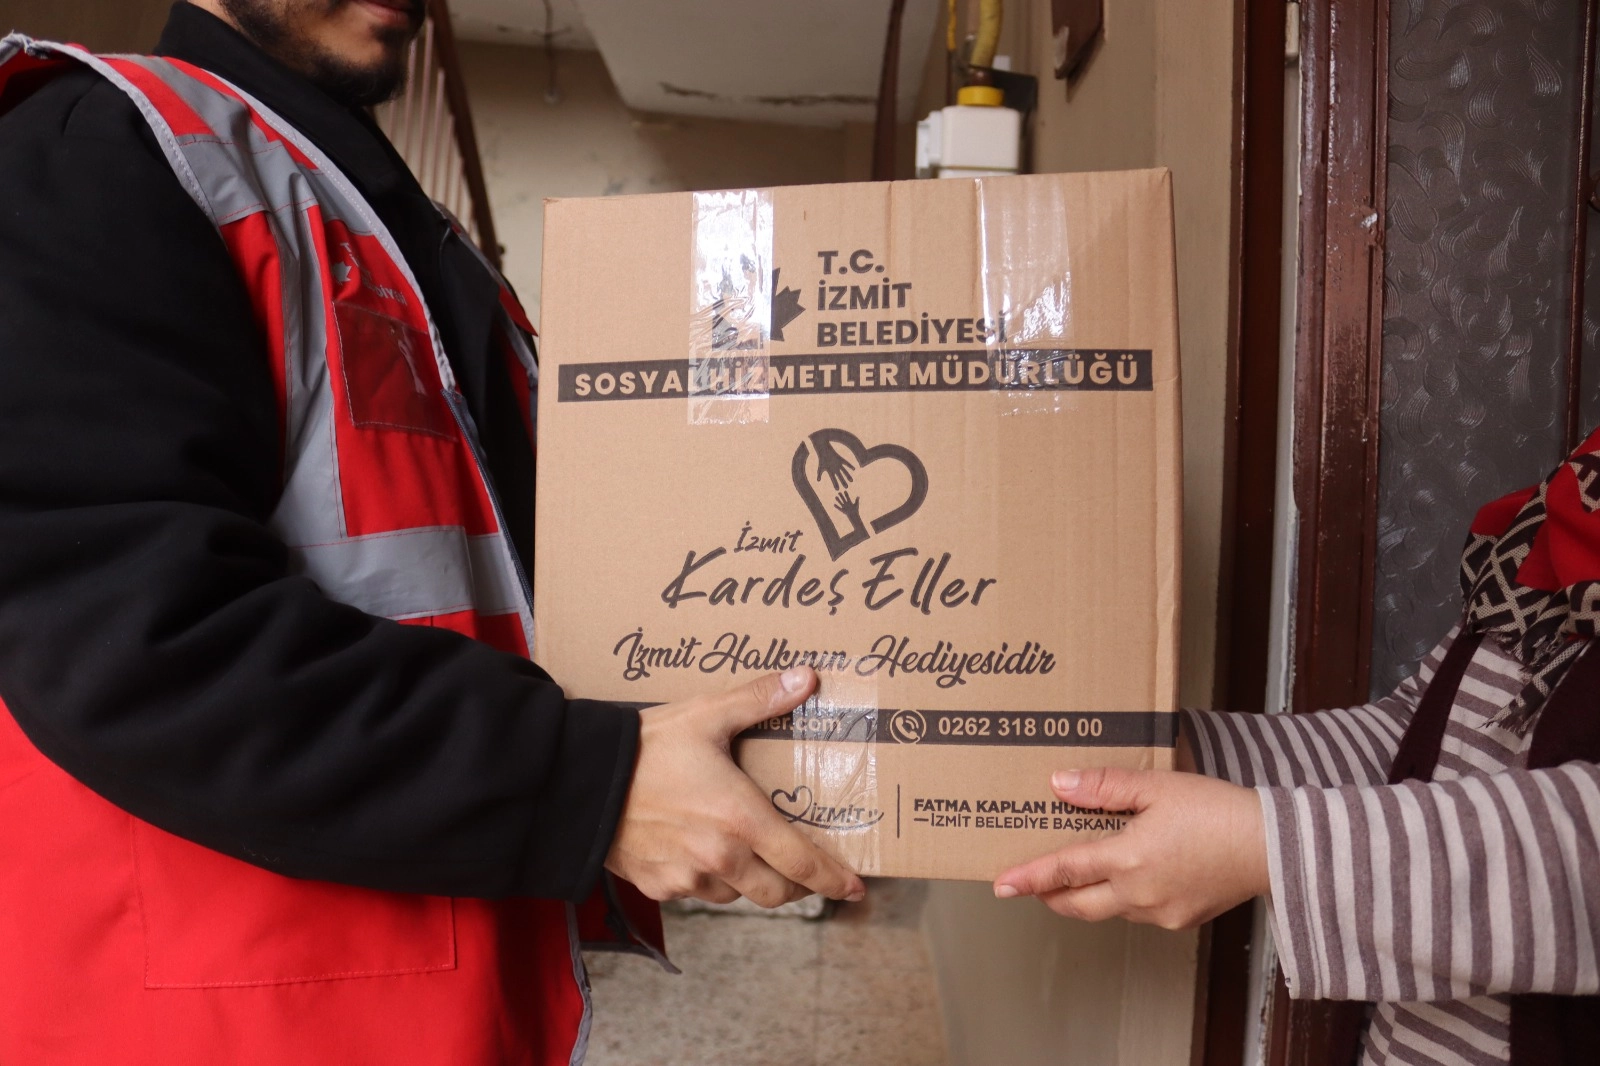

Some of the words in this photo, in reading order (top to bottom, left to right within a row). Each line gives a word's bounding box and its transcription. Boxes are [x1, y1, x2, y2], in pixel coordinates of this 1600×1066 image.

[818, 249, 885, 275] T.C.
[818, 277, 912, 311] İZMİT
[817, 310, 1008, 347] BELEDİYESİ
[575, 369, 702, 396] SOSYAL
[710, 360, 899, 392] HİZMETLER
[910, 353, 1138, 386] MÜDÜRLÜĞÜ
[734, 521, 803, 553] İzmit
[660, 547, 849, 615] Kardeş
[863, 547, 997, 615] Eller
[613, 627, 702, 681] İzmit
[855, 634, 1056, 689] Hediyesidir
[938, 716, 991, 736] 0262
[998, 717, 1037, 737] 318
[1044, 718, 1070, 737] 00
[1077, 718, 1103, 737] 00
[914, 799, 971, 813] FATMA
[976, 800, 1047, 814] KAPLAN
[975, 813, 1049, 830] BELEDİYE
